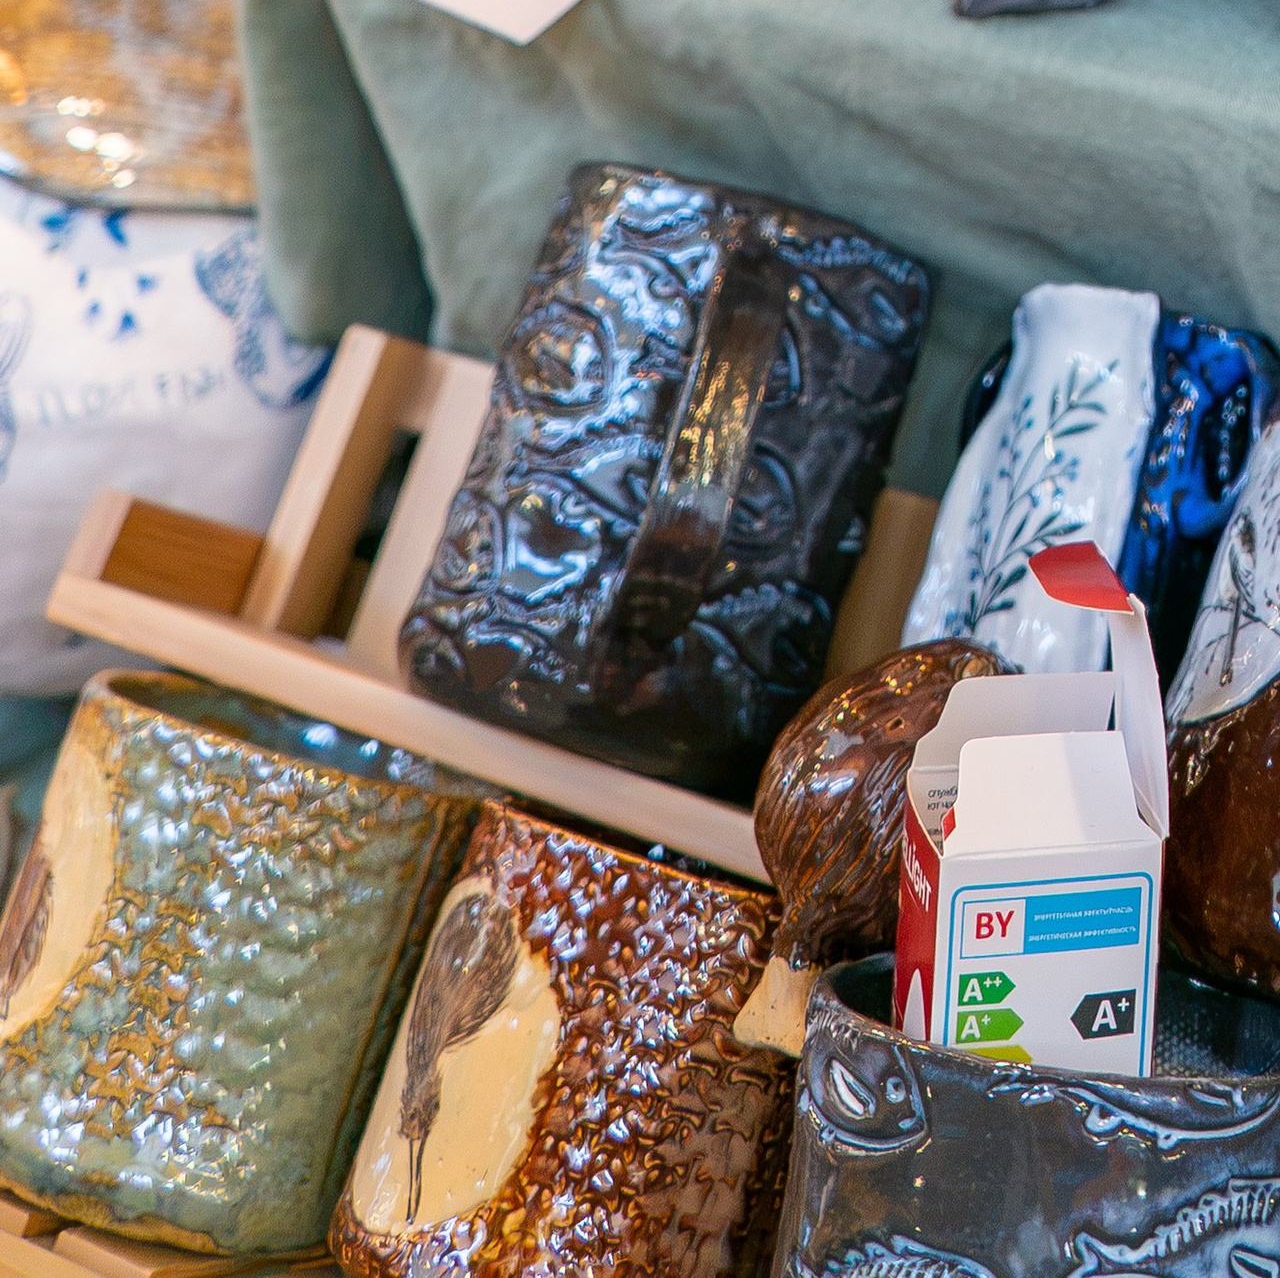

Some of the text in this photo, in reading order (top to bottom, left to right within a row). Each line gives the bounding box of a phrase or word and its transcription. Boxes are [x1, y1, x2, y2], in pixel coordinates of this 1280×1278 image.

[974, 909, 1015, 940] BY
[962, 975, 1003, 1003] A++
[960, 1013, 991, 1040] A+
[1091, 997, 1131, 1033] A+
